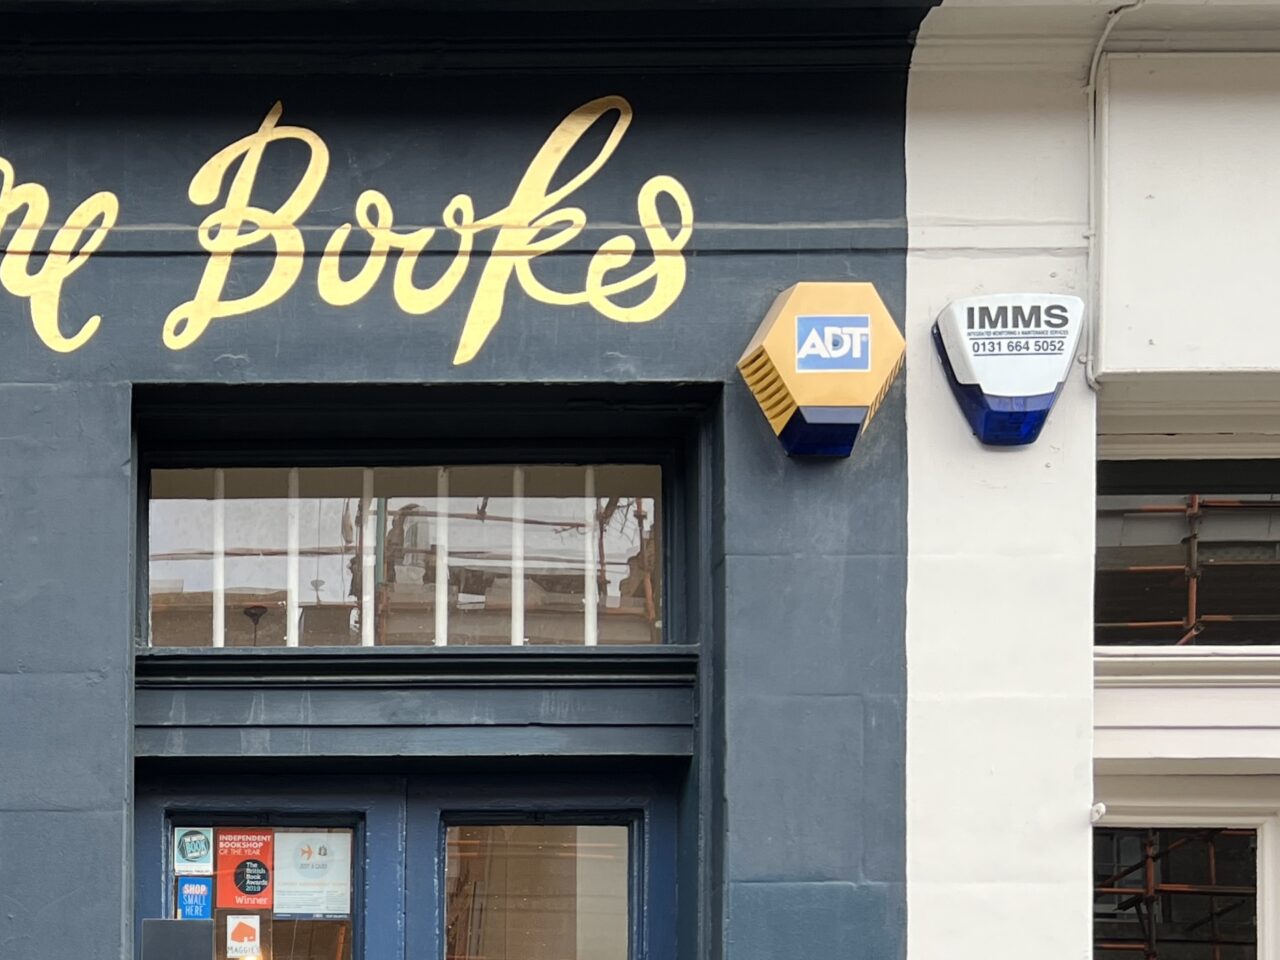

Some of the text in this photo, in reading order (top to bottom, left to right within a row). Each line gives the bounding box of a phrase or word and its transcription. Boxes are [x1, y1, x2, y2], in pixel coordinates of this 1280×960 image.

[163, 95, 693, 365] Books
[967, 304, 1069, 329] IMMS
[797, 327, 868, 358] ADT
[972, 340, 1064, 352] 0131 664 5052
[186, 840, 208, 854] BOOK
[183, 884, 207, 895] SHOP
[183, 895, 206, 906] SMALL
[235, 896, 269, 905] Winner
[185, 905, 203, 916] HERE
